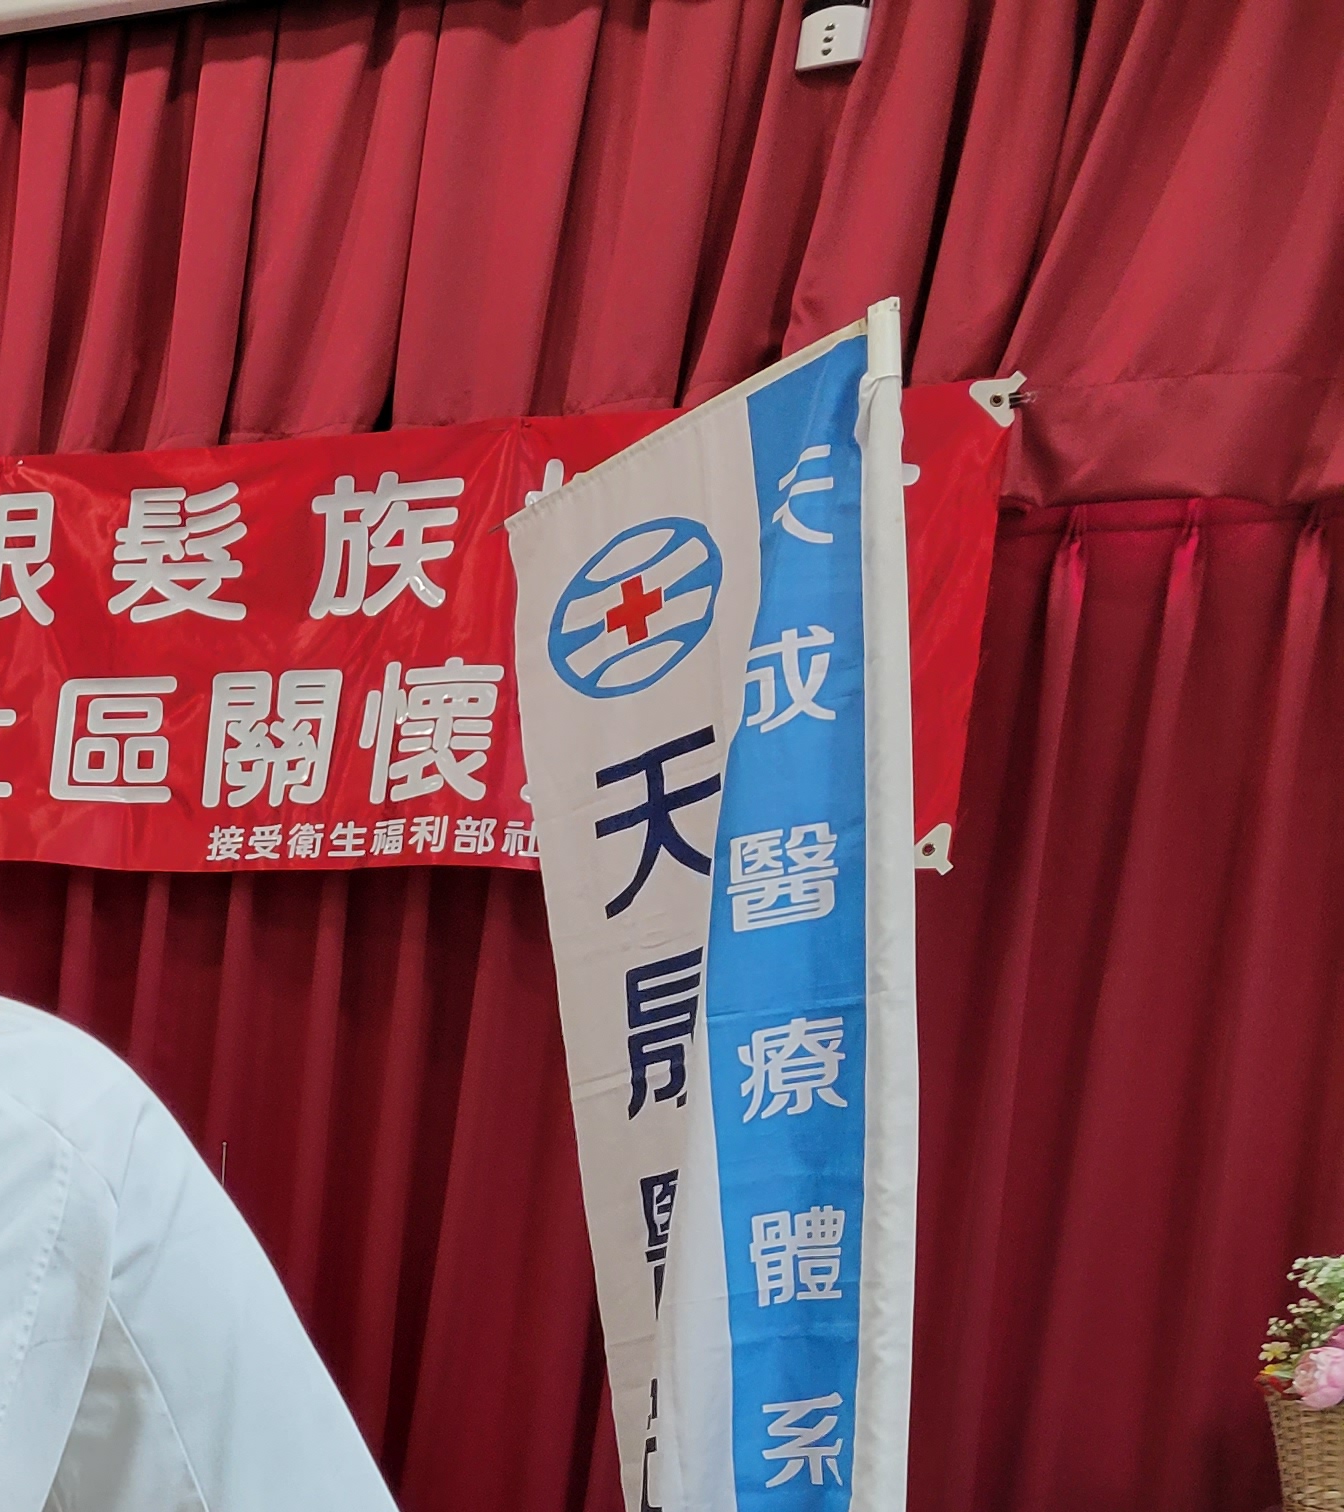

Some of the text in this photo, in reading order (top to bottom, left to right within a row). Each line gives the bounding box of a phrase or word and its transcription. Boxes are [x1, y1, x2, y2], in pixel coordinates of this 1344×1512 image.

[205, 814, 541, 862] 接受衛生福利部社
[727, 443, 848, 1490] 天成醫療體系
